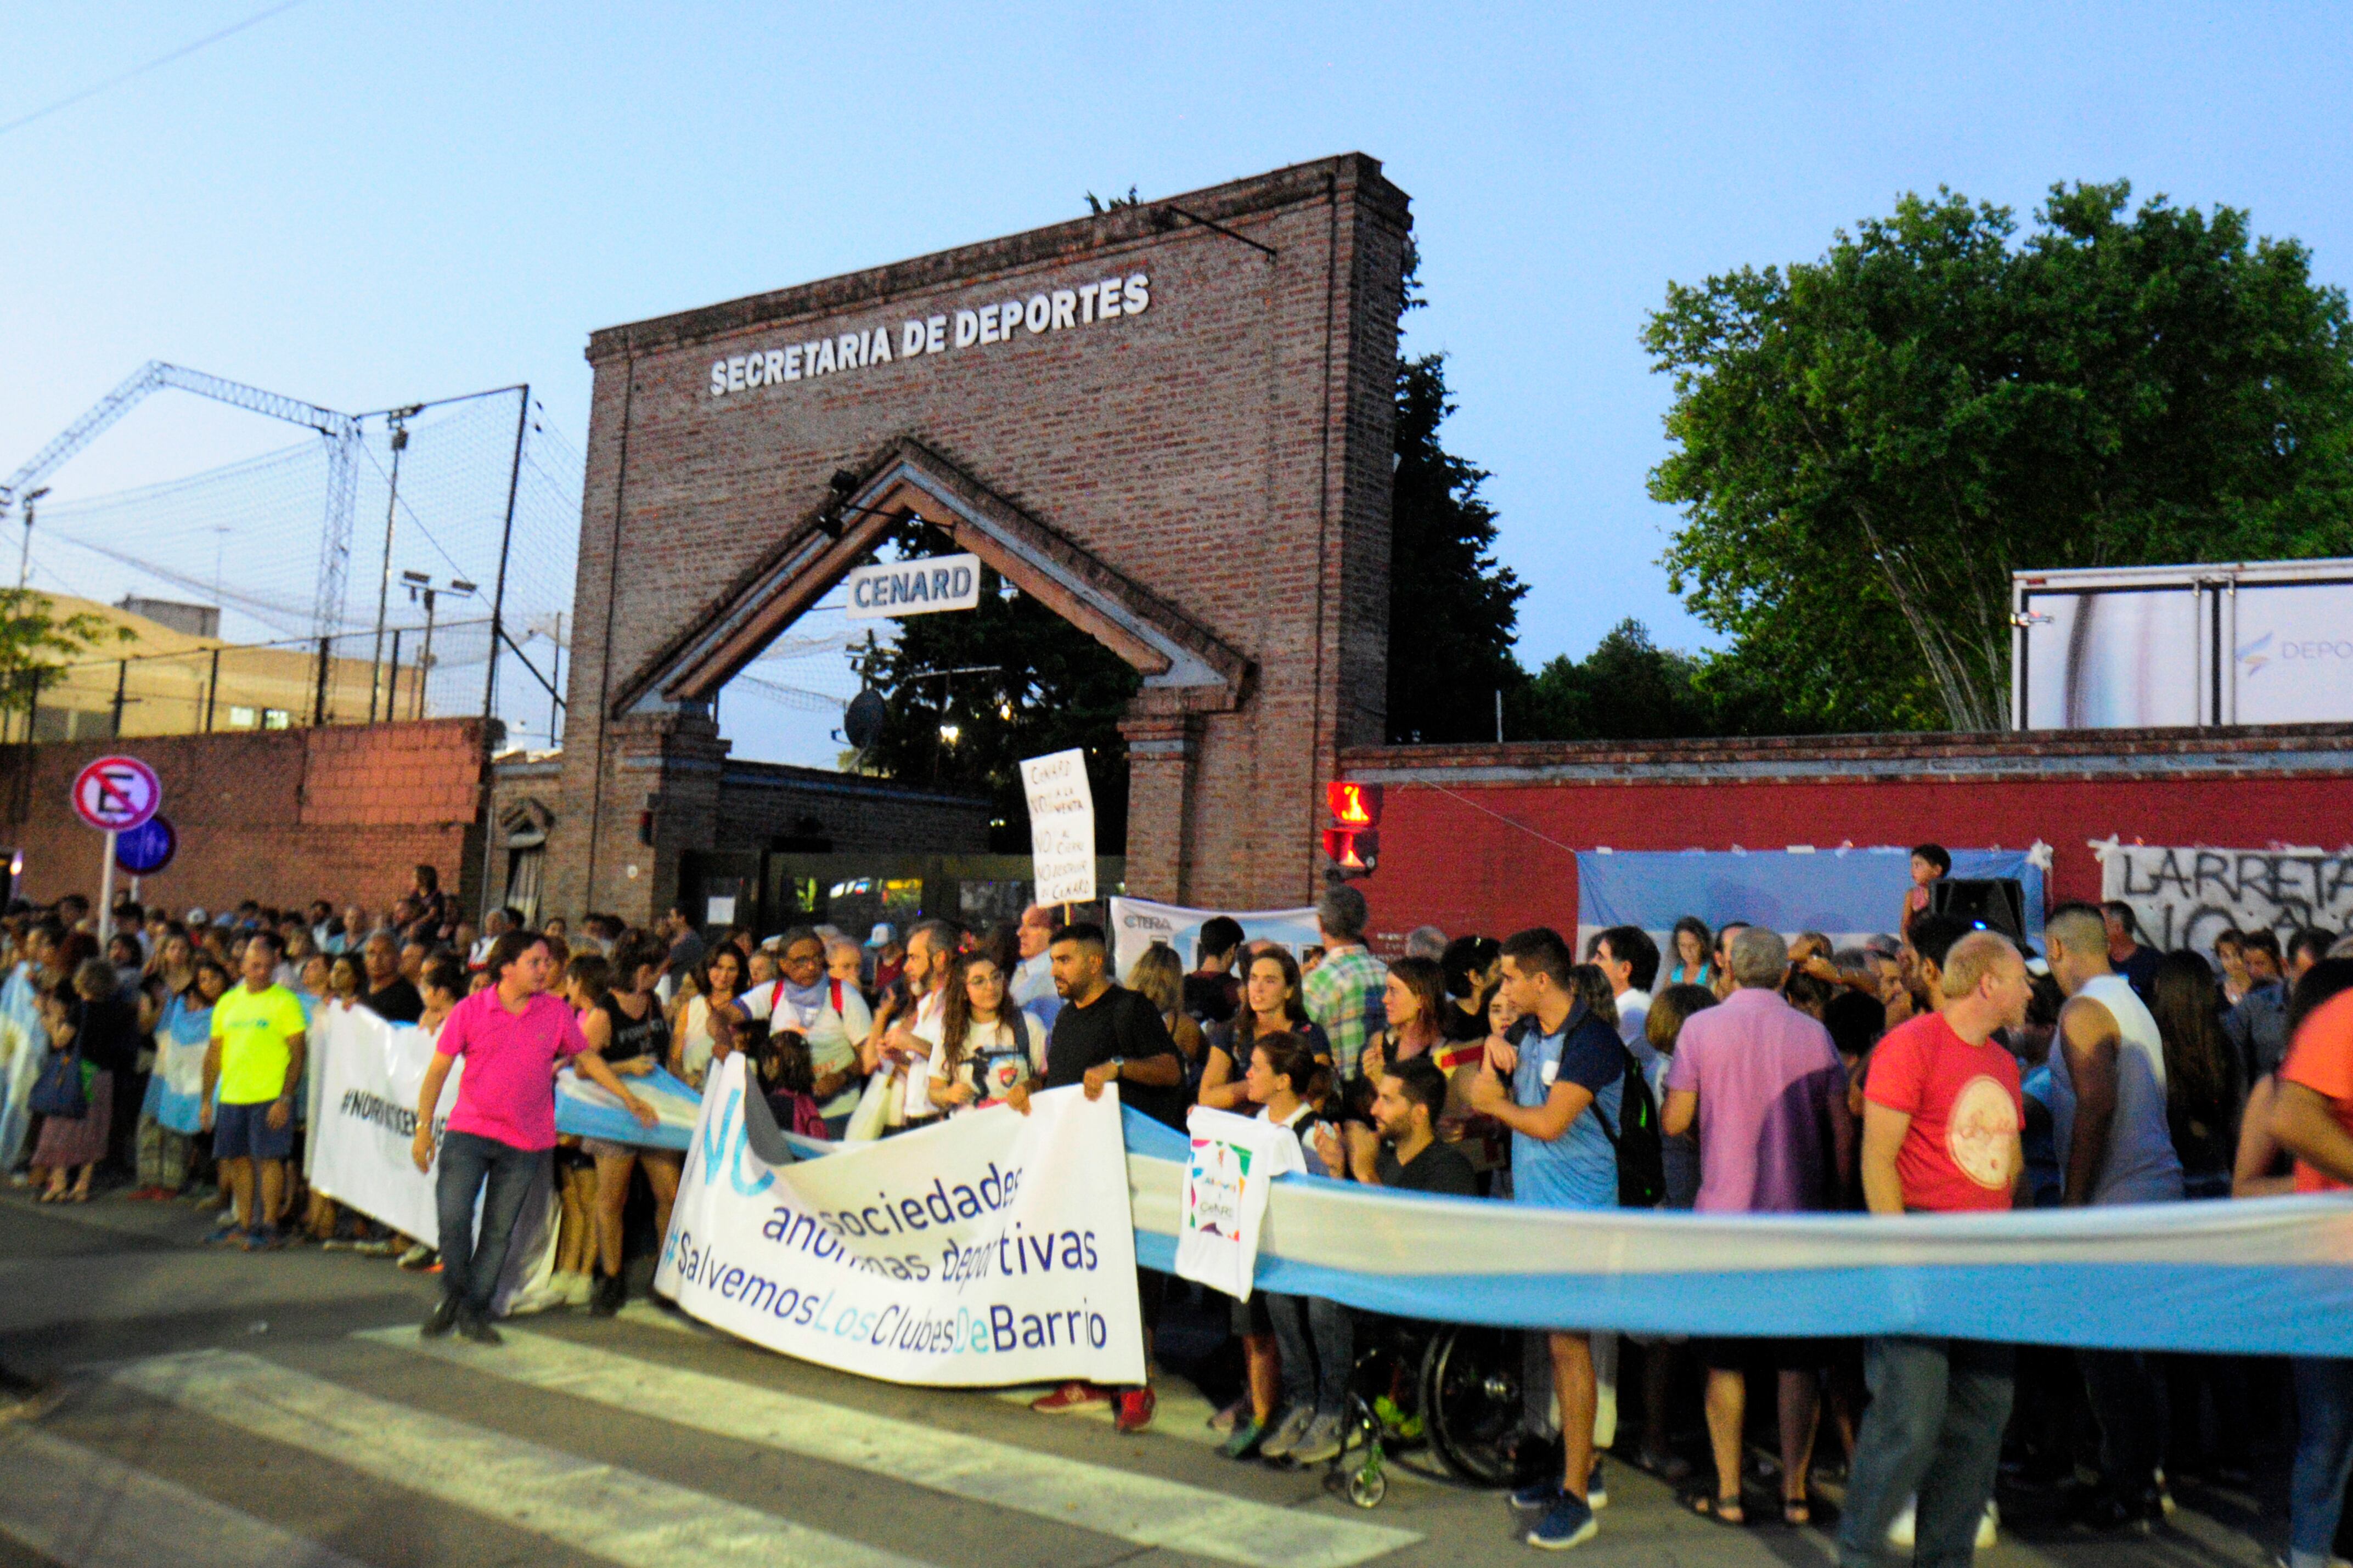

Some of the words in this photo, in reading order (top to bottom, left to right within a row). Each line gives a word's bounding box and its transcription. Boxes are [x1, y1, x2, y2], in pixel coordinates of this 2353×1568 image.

[710, 327, 892, 396] SECRETARIA
[902, 314, 947, 358] DE
[955, 273, 1150, 349] DEPORTES
[855, 566, 972, 608] CENARD
[1124, 915, 1173, 931] CTERA
